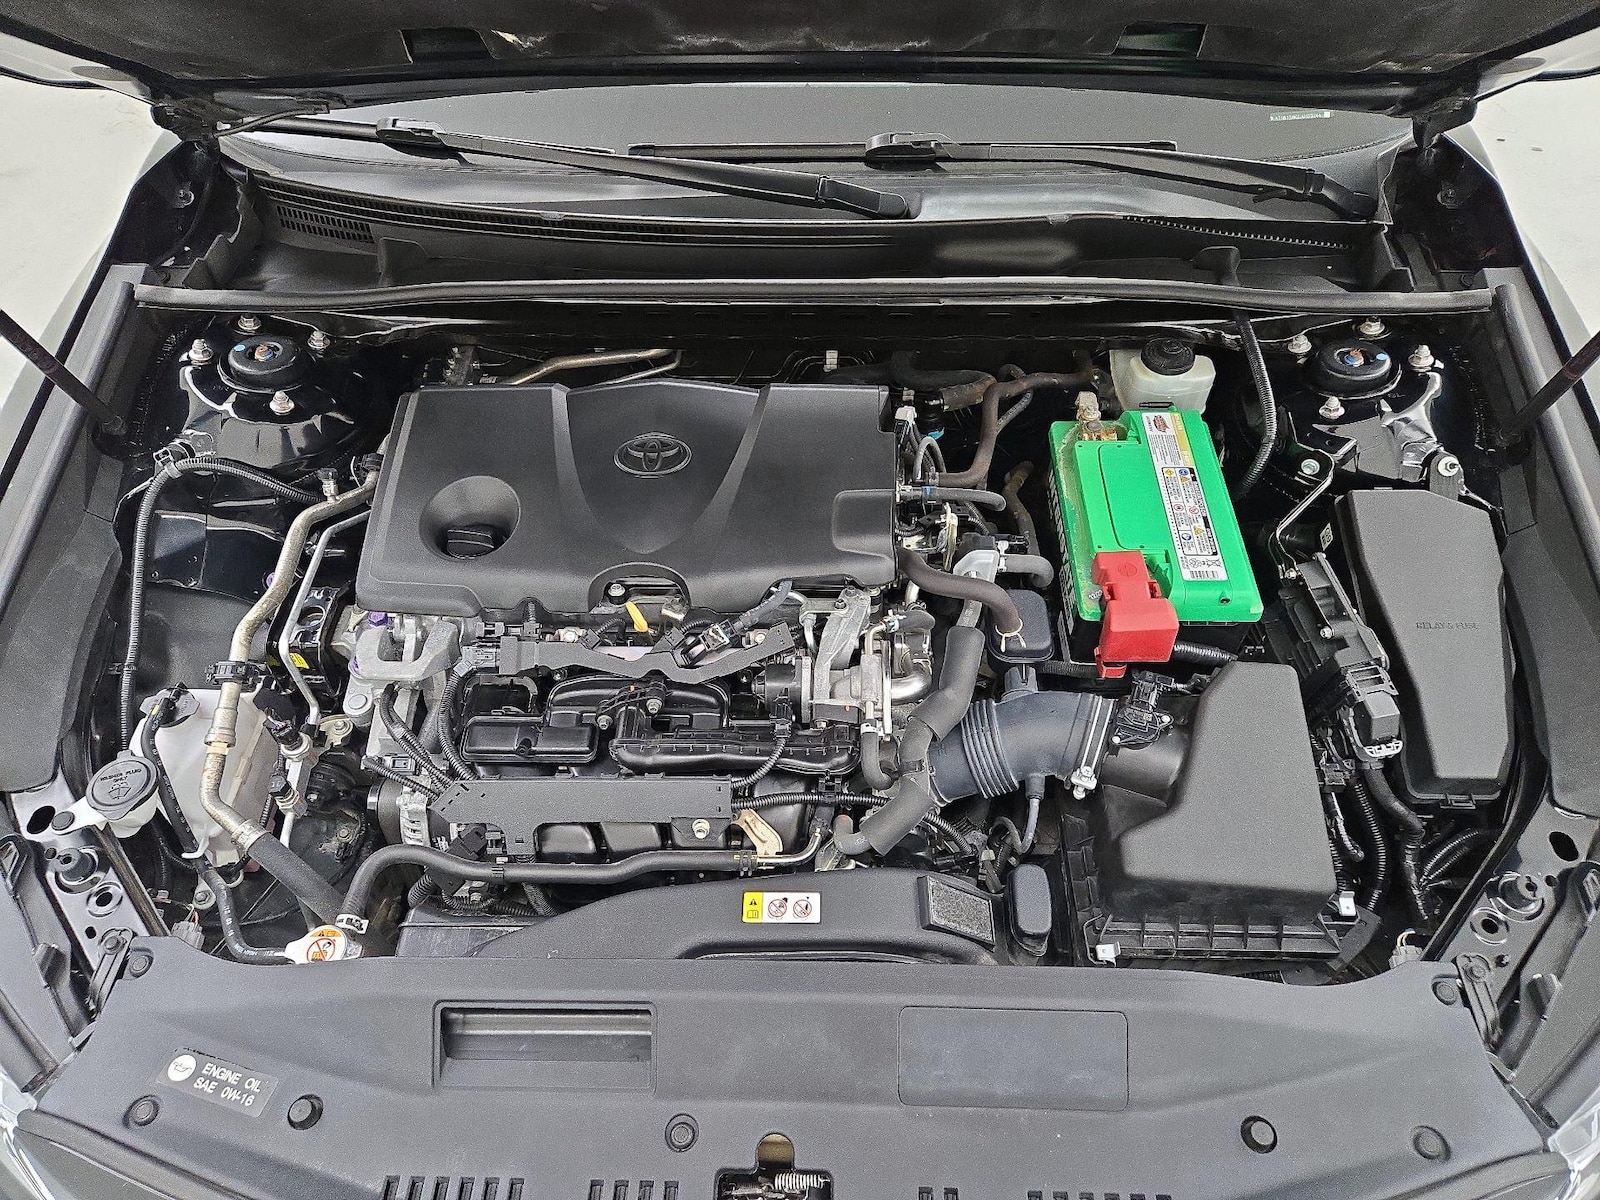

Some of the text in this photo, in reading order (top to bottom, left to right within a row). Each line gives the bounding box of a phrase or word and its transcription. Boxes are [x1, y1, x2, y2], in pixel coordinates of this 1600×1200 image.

[1416, 621, 1445, 630] RELAY
[193, 1077, 255, 1107] SAE 0W-16
[202, 1062, 261, 1093] ENGINE OIL
